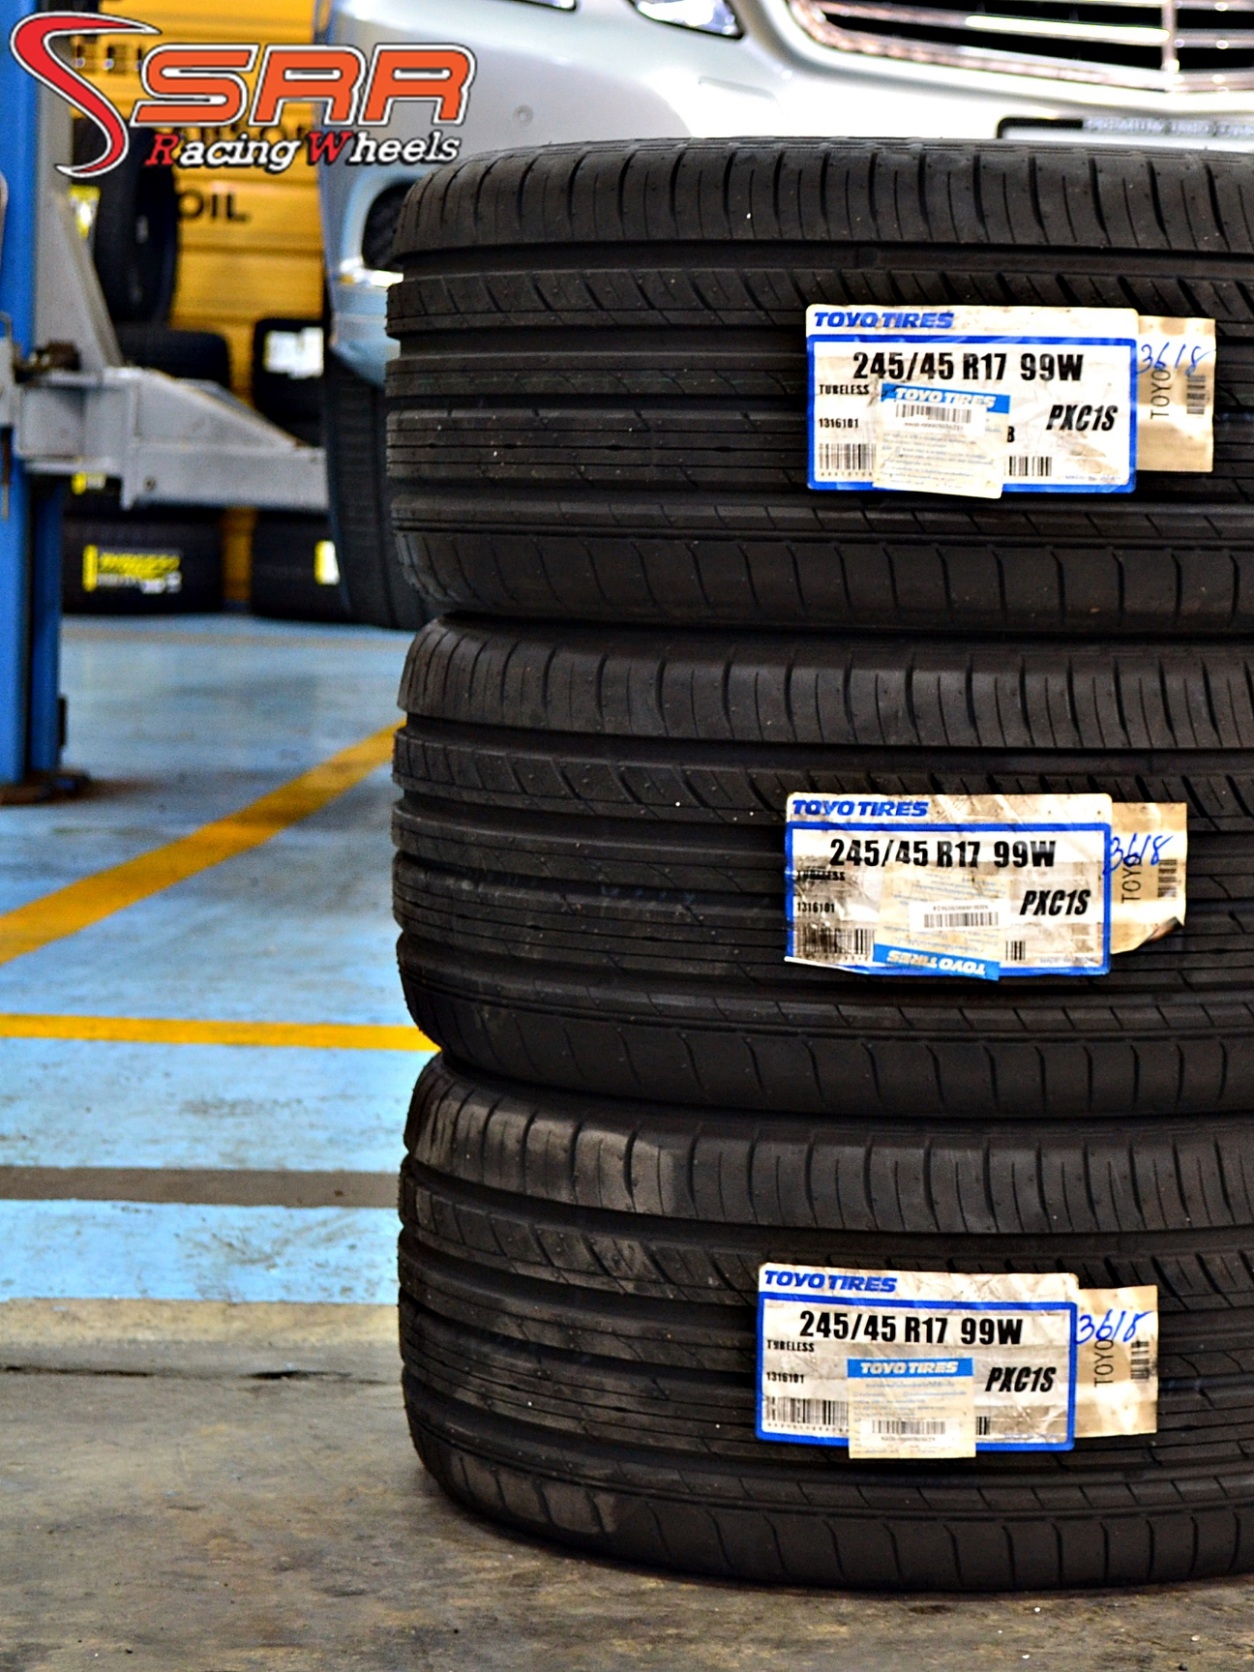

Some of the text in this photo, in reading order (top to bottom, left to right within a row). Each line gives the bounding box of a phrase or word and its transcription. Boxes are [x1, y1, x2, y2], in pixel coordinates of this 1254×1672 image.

[853, 351, 1084, 382] 245/45 R17 99W
[819, 383, 870, 395] TUBELESS
[1150, 366, 1172, 419] TOYO
[1046, 404, 1119, 432] PXC1S
[829, 838, 1056, 868] 245/45 R17 99W
[1121, 854, 1142, 904] TOYO
[1019, 889, 1092, 916] PXC1S
[799, 1310, 1024, 1346] 245/45 R17 99W
[767, 1339, 815, 1353] TUBELESS
[1094, 1338, 1114, 1388] TOYO
[985, 1366, 1057, 1392] PXC1S
